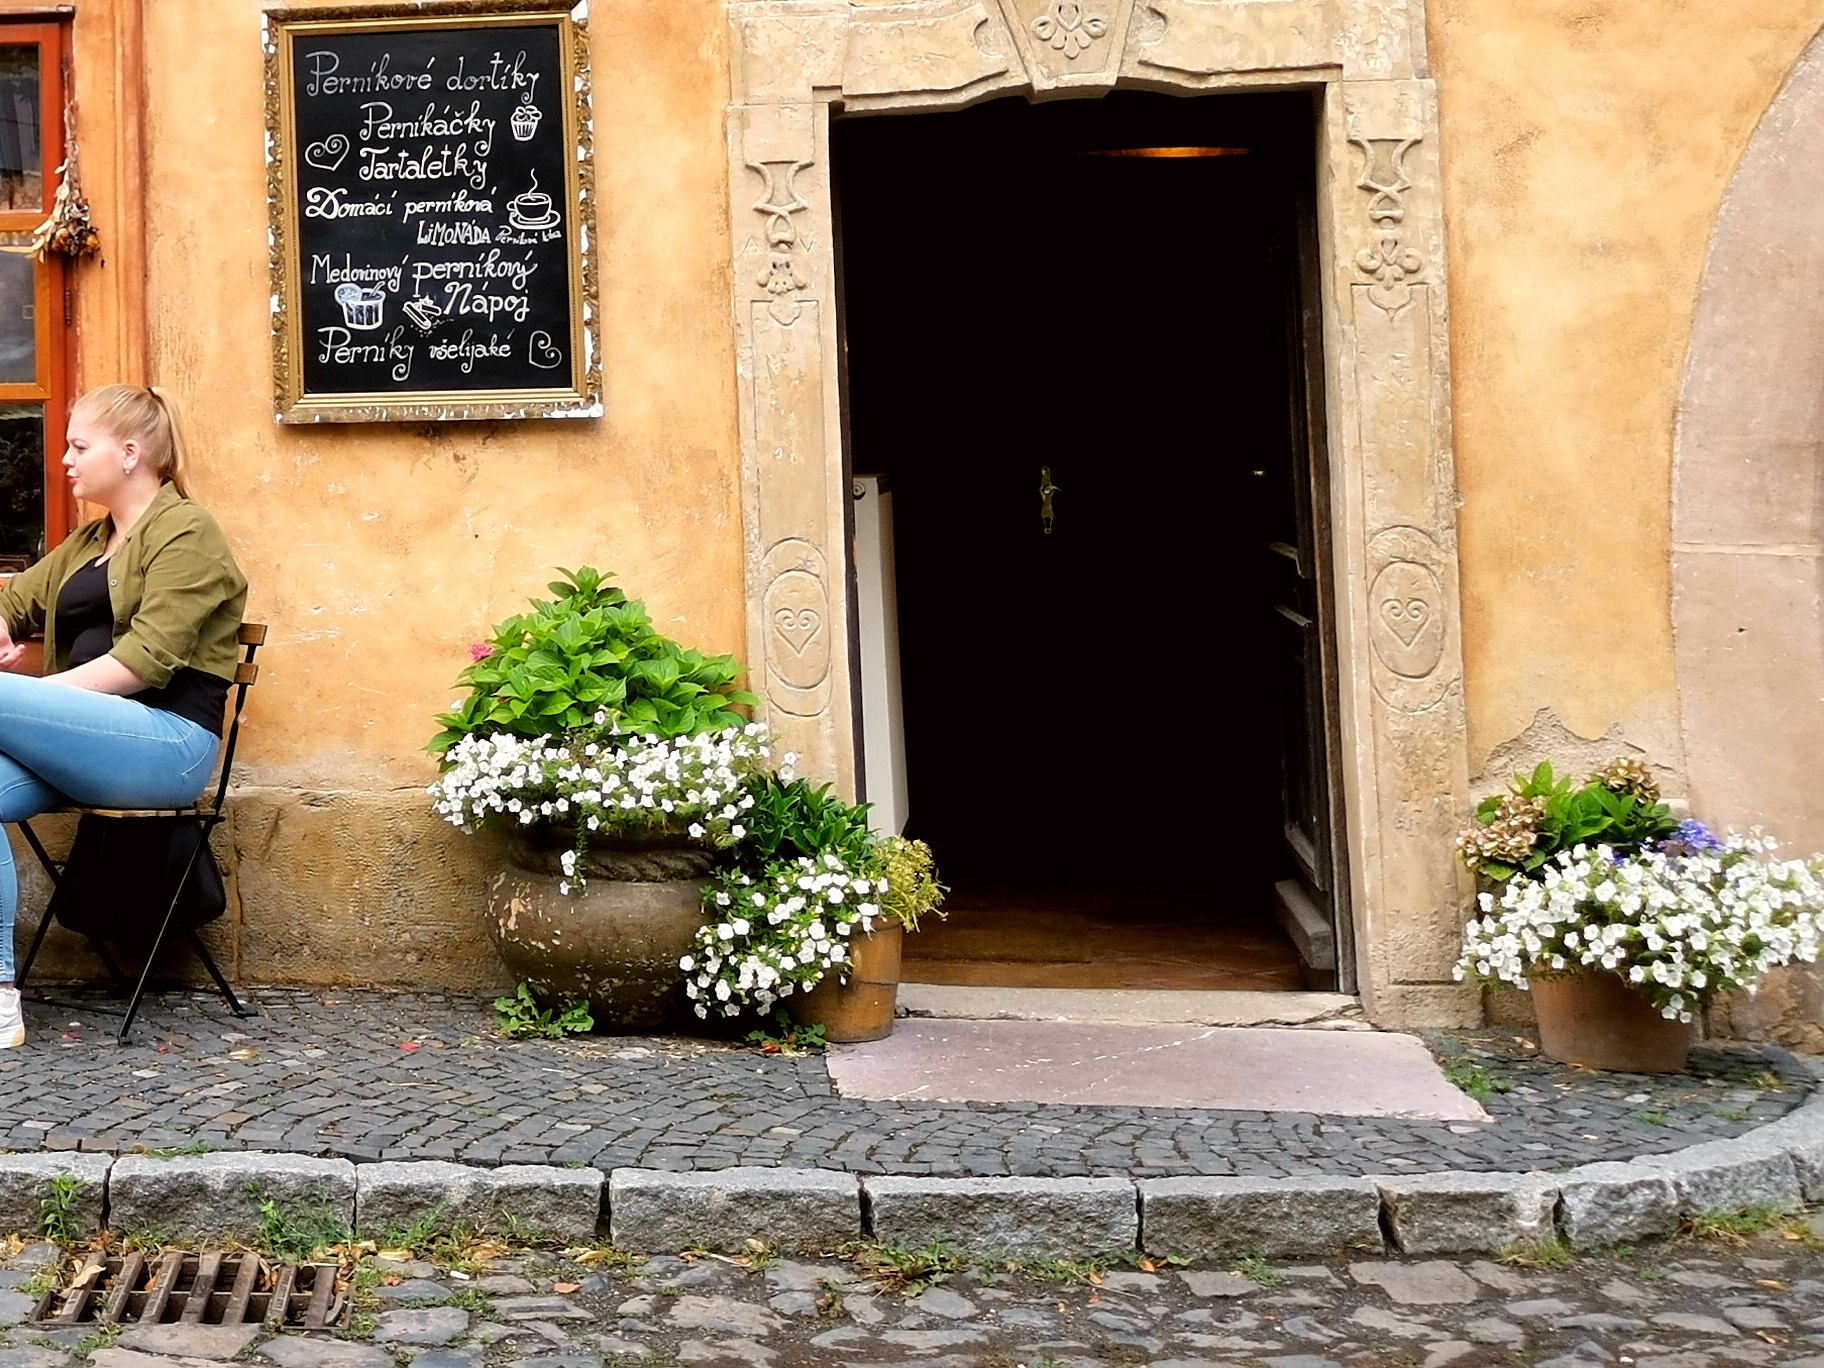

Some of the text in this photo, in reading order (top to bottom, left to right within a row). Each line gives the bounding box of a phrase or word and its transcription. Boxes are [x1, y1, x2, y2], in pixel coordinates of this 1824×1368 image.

[305, 50, 540, 105] Perníkové dortíky
[359, 100, 497, 157] Perníkáčky
[358, 142, 488, 190] Tartaletky
[304, 186, 498, 224] Domácí perníková
[310, 248, 538, 298] Medovinový perníkový
[443, 281, 531, 323] Nápoj
[317, 325, 516, 382] Perníky všelijaké
